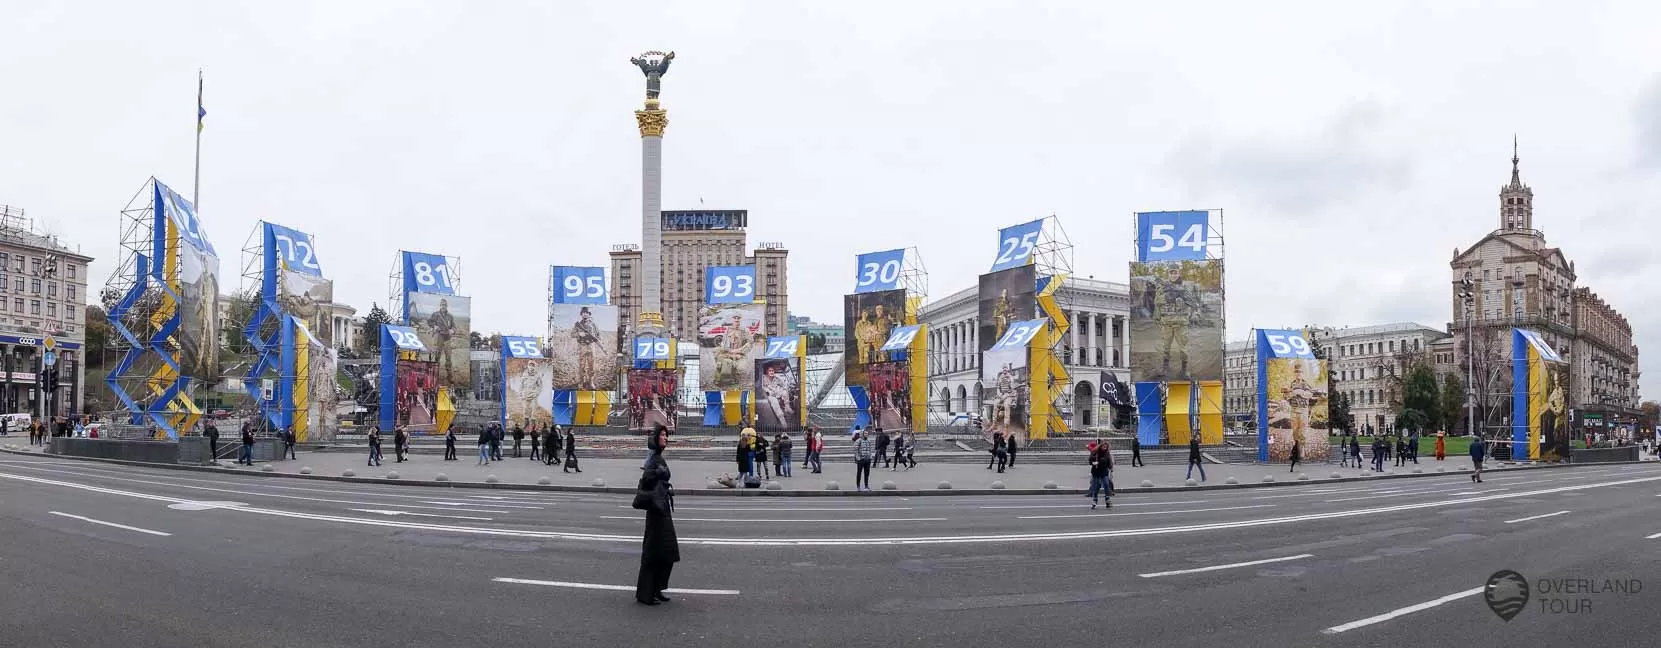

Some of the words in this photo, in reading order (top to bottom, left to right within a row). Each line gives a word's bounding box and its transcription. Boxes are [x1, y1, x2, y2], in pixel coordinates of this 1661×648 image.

[999, 233, 1037, 262] 25
[1150, 223, 1206, 252] 54
[277, 234, 318, 268] 72
[416, 262, 451, 287] 81
[859, 260, 900, 286] 30
[564, 275, 603, 297] 95
[713, 275, 752, 297] 93
[390, 329, 423, 348] 28
[511, 340, 540, 356] 55
[637, 341, 669, 358] 79
[769, 339, 798, 355] 74
[886, 330, 916, 347] 44
[1269, 334, 1310, 355] 59
